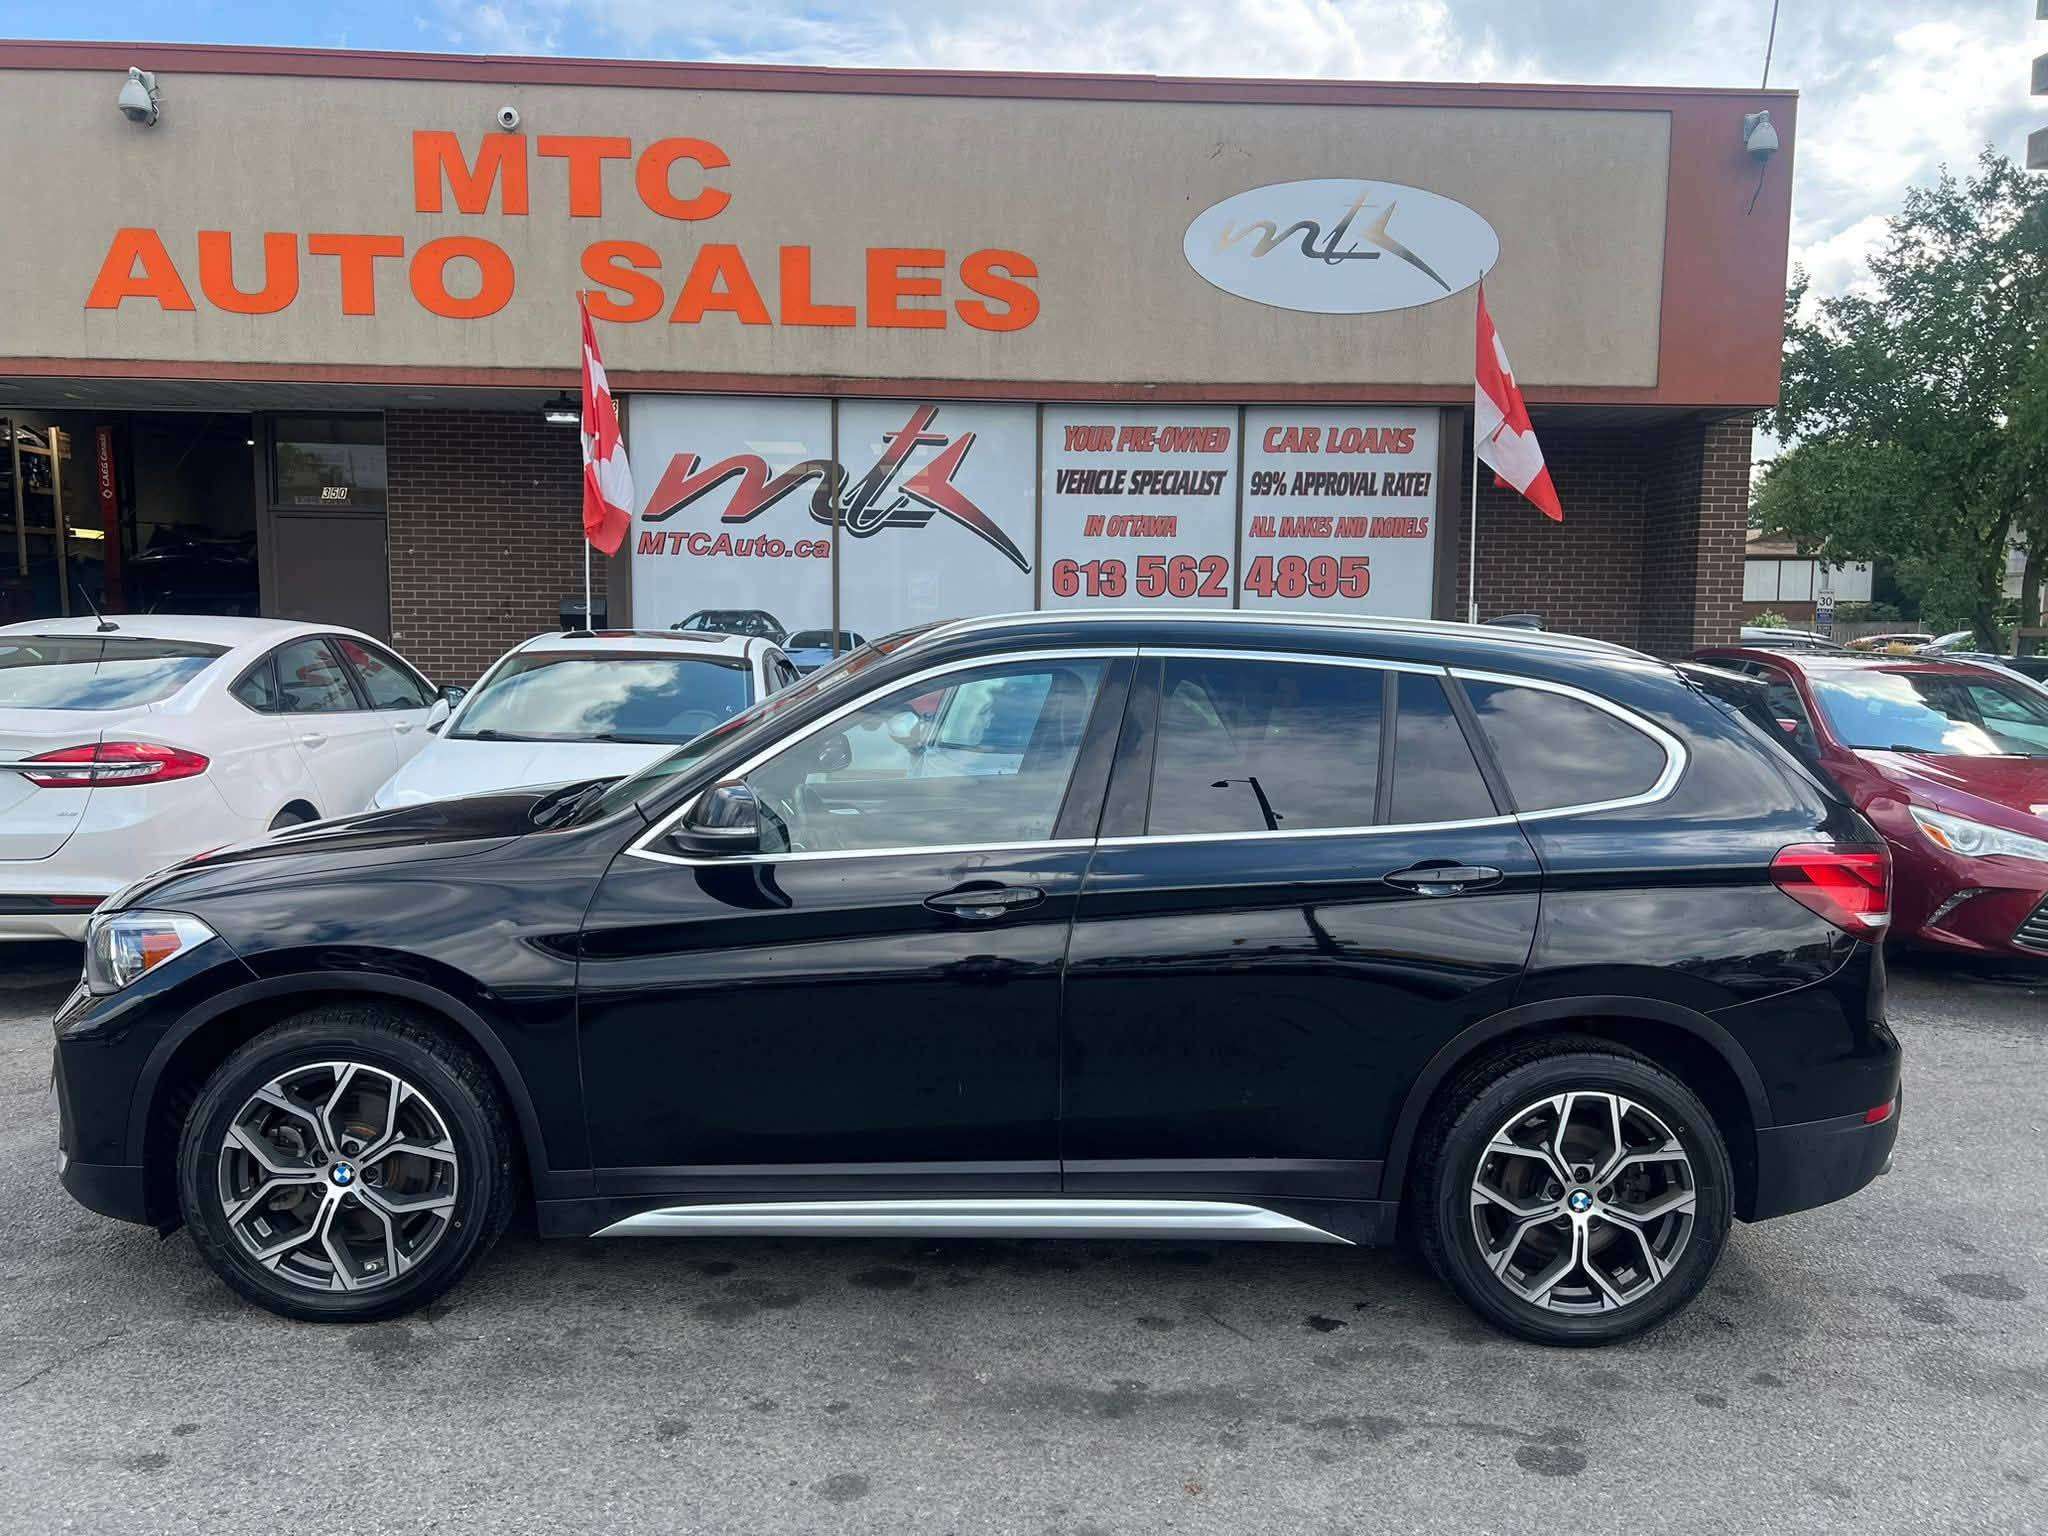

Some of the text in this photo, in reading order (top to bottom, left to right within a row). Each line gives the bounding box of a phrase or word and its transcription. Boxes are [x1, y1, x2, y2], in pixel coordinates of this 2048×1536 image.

[412, 130, 732, 221] MTC
[84, 227, 1040, 332] AUTO SALES
[1064, 425, 1231, 454] YOUR PRE-OWNED
[1262, 426, 1417, 454] CAR LOANS
[321, 487, 347, 499] 350
[1056, 469, 1229, 496] VEHICLE SPECIALIST
[1250, 471, 1432, 497] 99% APPROVAL RATE!
[1083, 515, 1178, 538] IN OTTAWA
[1249, 516, 1429, 539] ALL MAKES AND MODELS
[637, 531, 831, 560] MTCAuto.ca
[1052, 555, 1371, 598] 613 562 4895
[1819, 596, 1833, 606] 30
